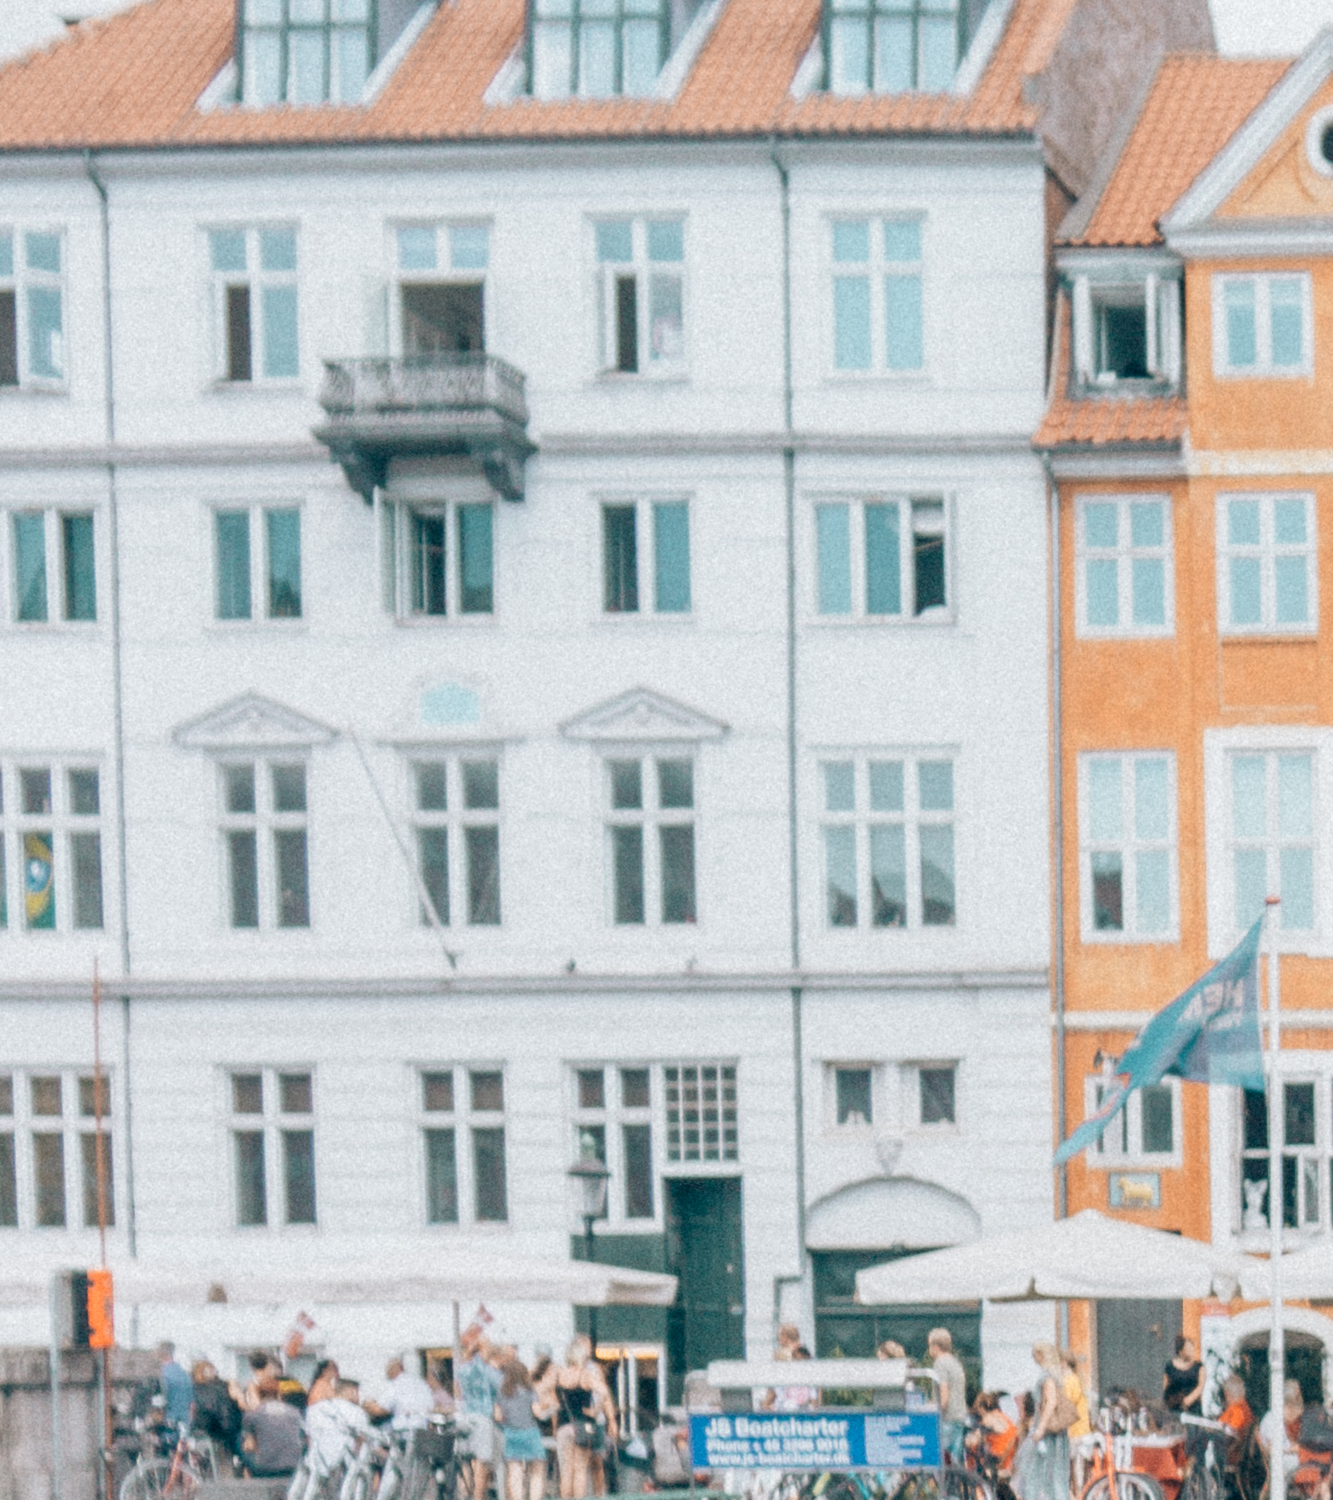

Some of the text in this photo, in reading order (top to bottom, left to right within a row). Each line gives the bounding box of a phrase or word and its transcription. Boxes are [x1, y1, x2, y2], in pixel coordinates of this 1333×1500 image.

[705, 1416, 849, 1438] JS Boatcharter
[706, 1437, 749, 1451] Phone
